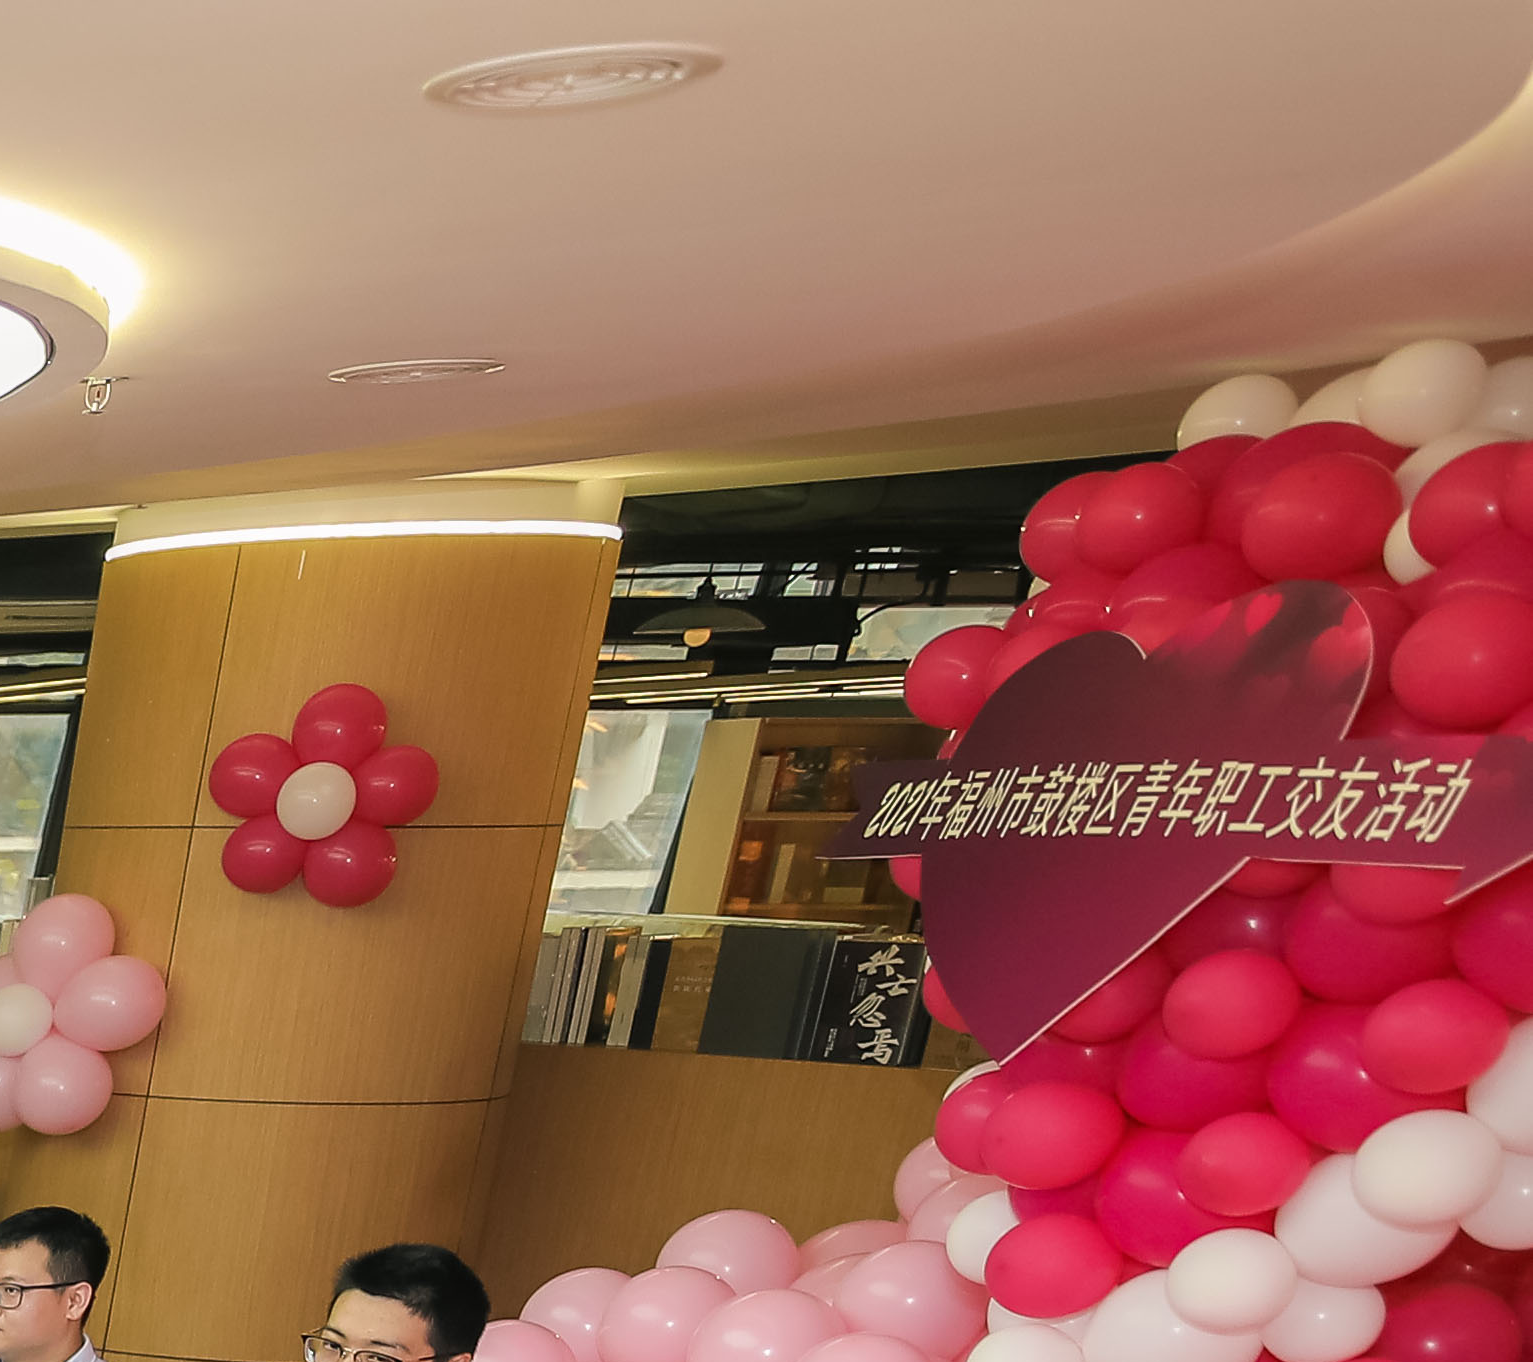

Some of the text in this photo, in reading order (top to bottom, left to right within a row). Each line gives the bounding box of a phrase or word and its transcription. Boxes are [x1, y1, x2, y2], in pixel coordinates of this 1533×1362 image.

[863, 756, 1473, 842] 2021年福州市鼓楼区青年职工交友活动
